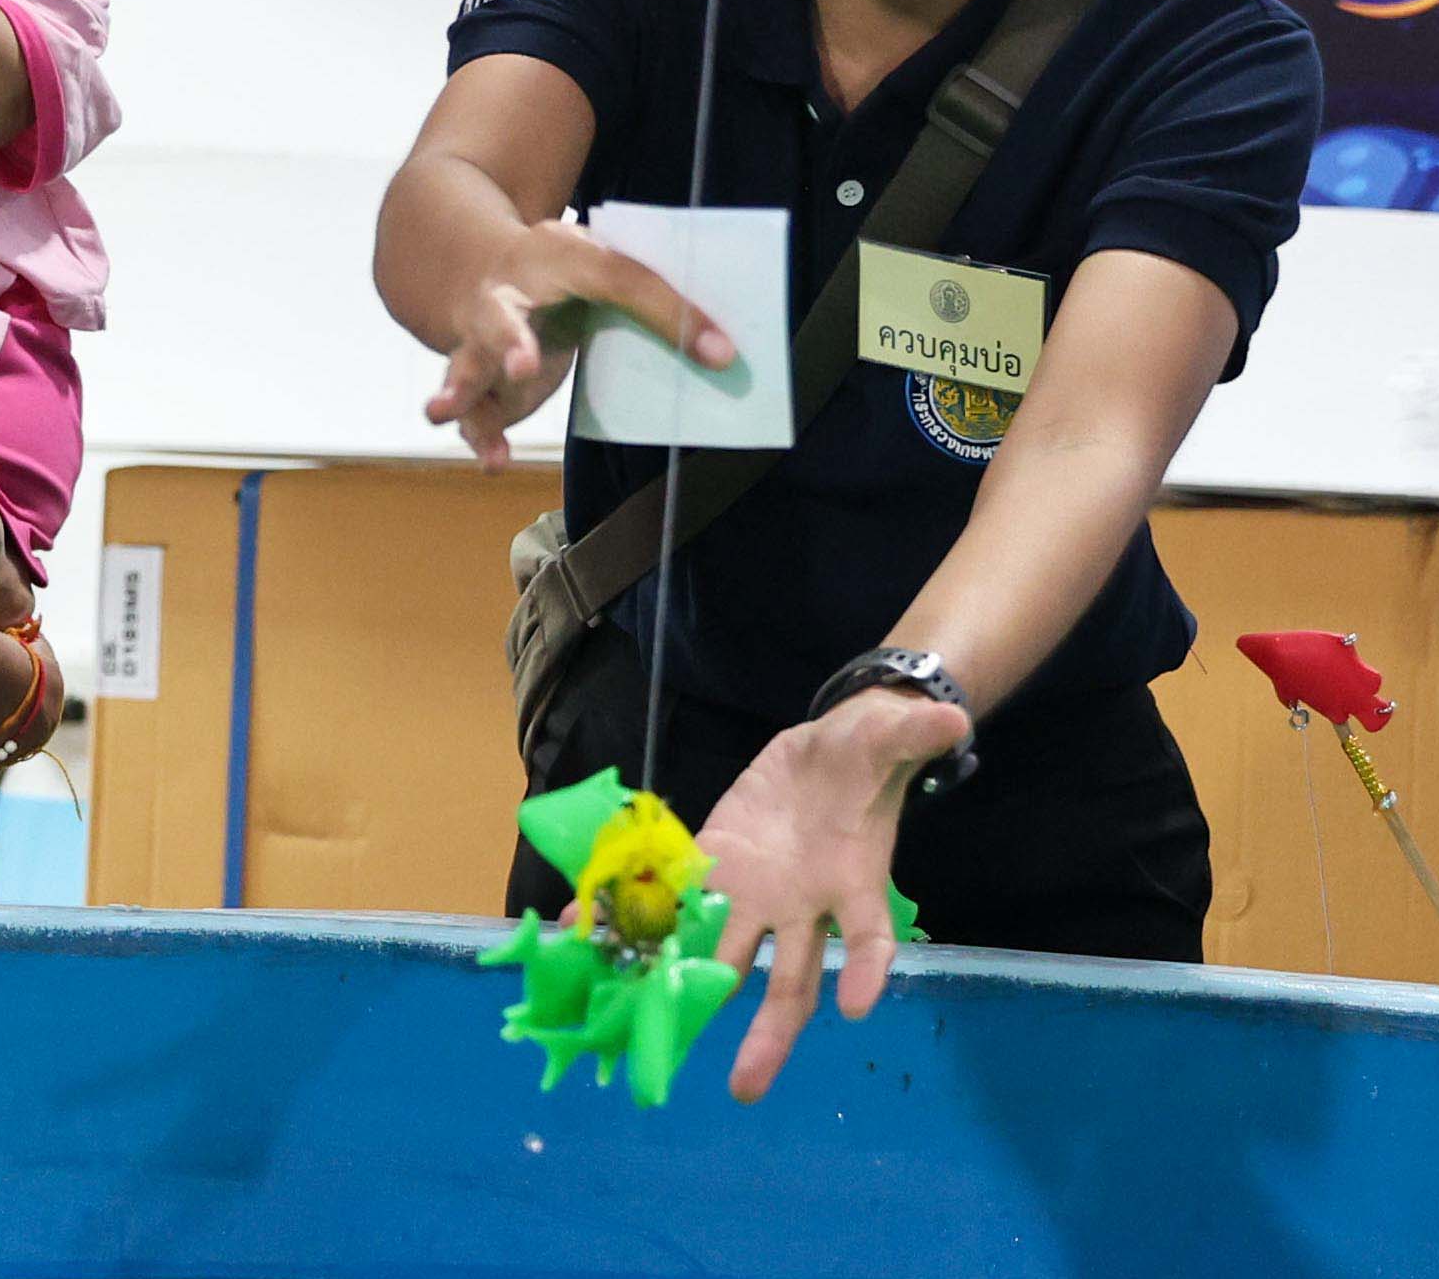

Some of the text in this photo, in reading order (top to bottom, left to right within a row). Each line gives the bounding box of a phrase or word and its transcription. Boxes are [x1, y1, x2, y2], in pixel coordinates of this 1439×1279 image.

[879, 324, 1021, 379] ควบคุมบ่อ
[913, 392, 998, 460] กระทรวงเกษต
